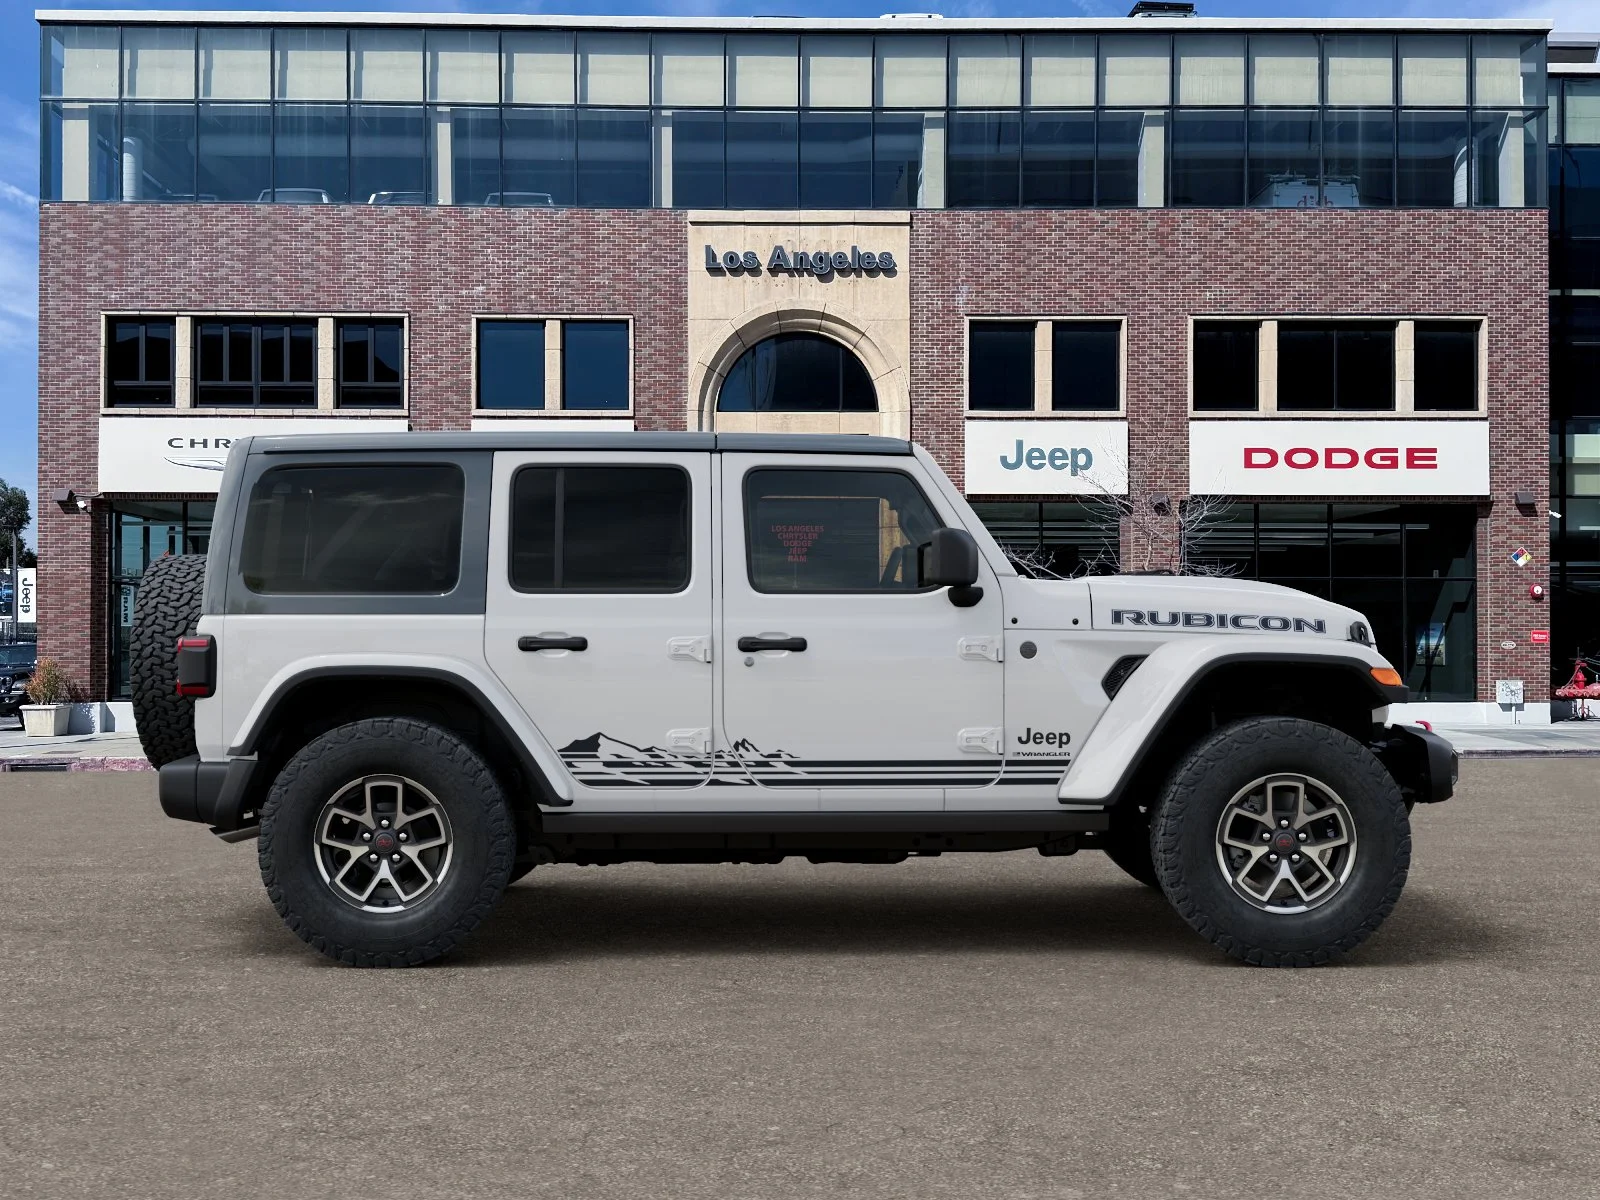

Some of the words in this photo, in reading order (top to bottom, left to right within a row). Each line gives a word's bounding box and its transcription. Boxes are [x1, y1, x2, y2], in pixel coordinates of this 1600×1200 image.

[705, 245, 758, 269] Los
[767, 245, 894, 275] Angeles
[1000, 439, 1093, 476] Jeep
[1244, 447, 1438, 469] DODGE
[777, 532, 818, 540] CHRYSLER
[20, 577, 33, 613] Jeep
[1111, 608, 1327, 634] RUBICON
[1017, 727, 1071, 749] Jeep
